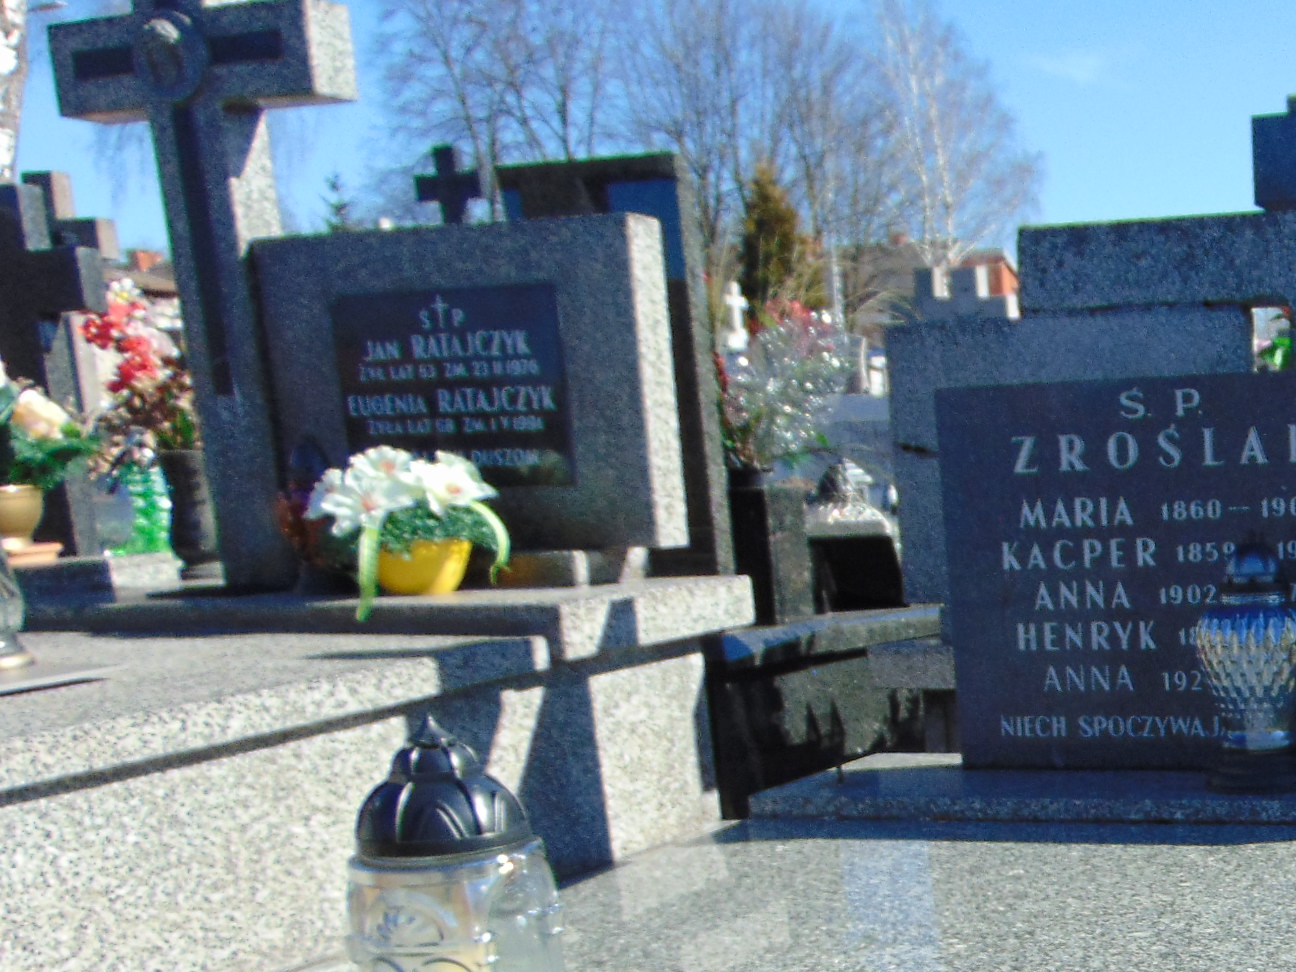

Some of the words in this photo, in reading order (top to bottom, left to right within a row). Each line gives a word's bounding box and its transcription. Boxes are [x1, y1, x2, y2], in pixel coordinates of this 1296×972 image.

[364, 340, 400, 362] JAN
[410, 329, 532, 359] RATAJCZYK
[348, 394, 428, 417] EUGENIA
[437, 386, 557, 414] RATAJCZYK
[1174, 388, 1203, 417] P.
[1020, 496, 1134, 529] MARIA
[1161, 499, 1221, 522] 1860
[1001, 537, 1157, 570] KACPER
[1034, 580, 1131, 611] ANNA
[1159, 583, 1217, 605] 1902
[1016, 619, 1158, 651] HENRYK
[1043, 664, 1135, 693] ANNA
[1000, 715, 1067, 740] NIECH
